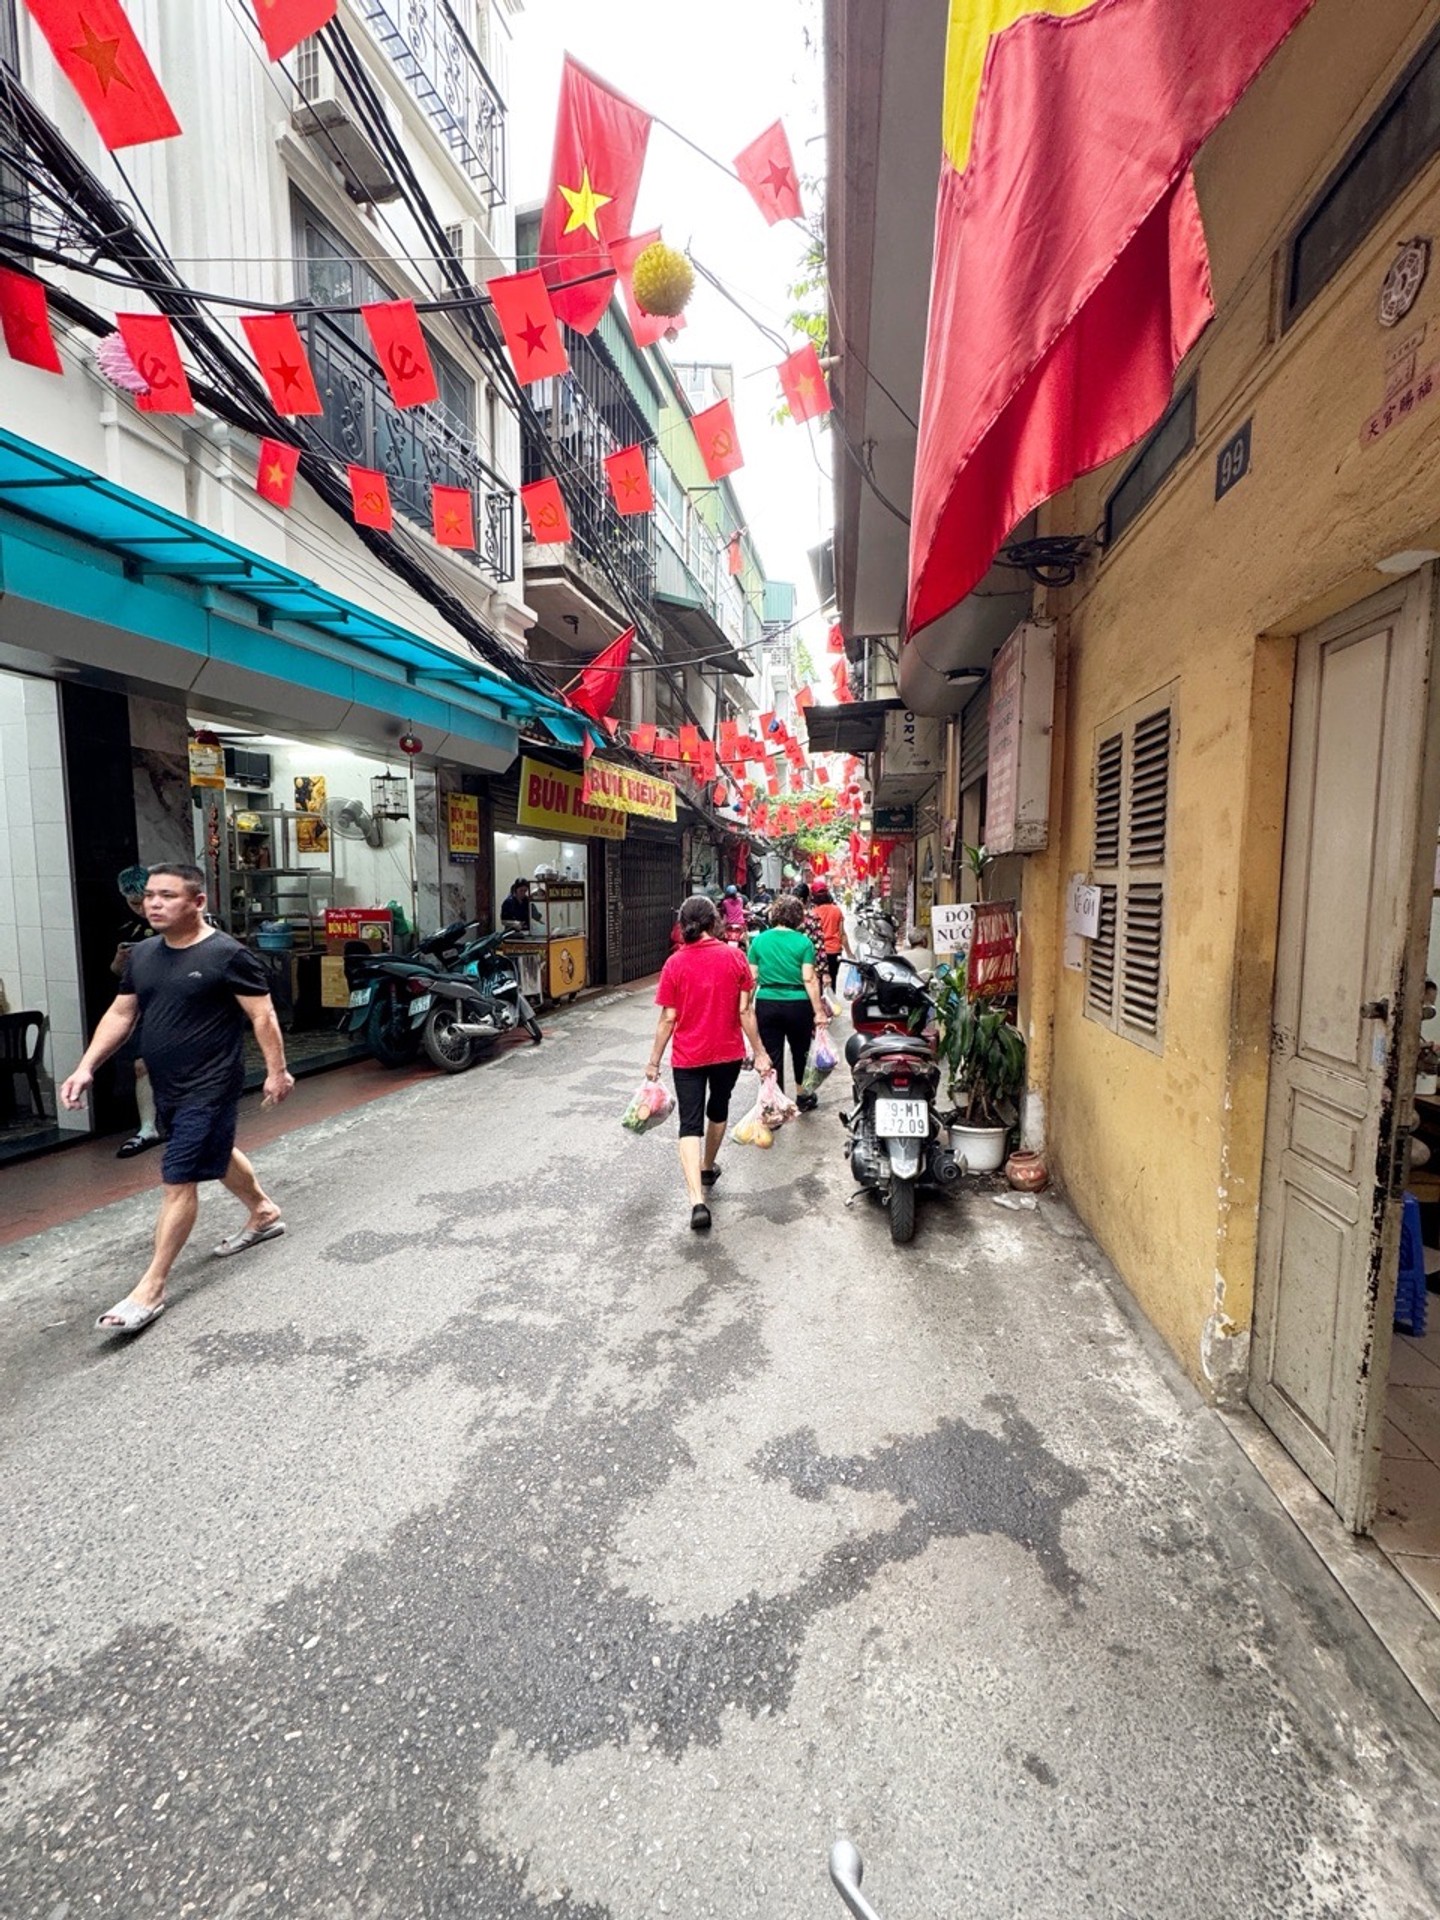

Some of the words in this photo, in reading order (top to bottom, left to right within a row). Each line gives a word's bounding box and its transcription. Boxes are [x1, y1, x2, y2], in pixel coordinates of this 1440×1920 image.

[1222, 438, 1244, 487] 99
[527, 771, 570, 814] BÚN
[938, 925, 972, 941] NƯỚ
